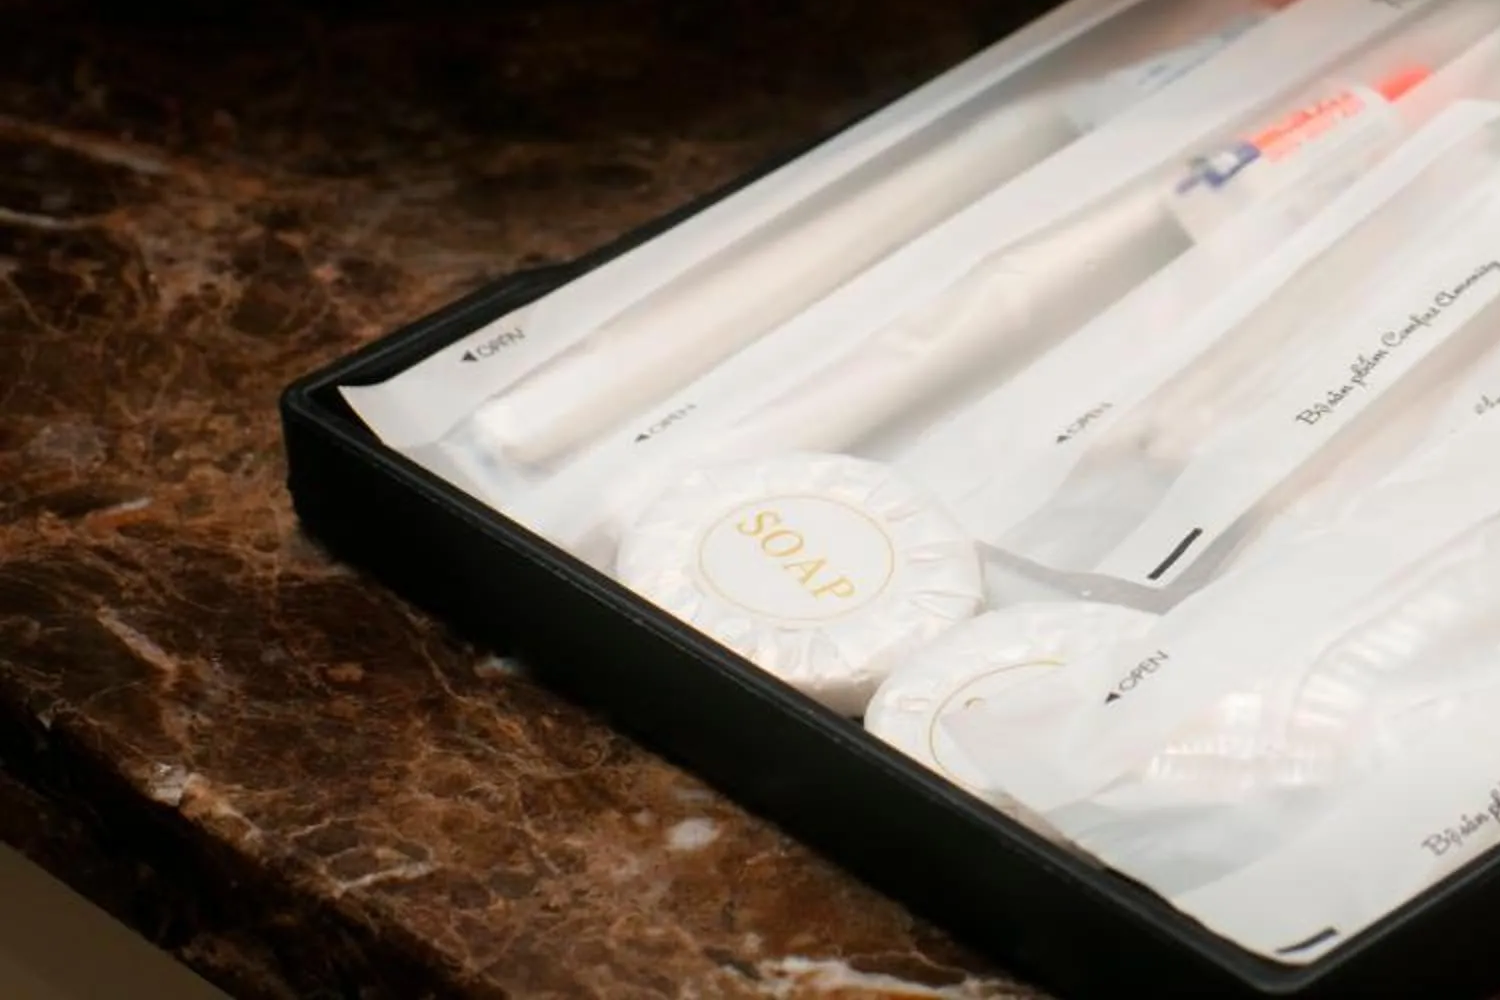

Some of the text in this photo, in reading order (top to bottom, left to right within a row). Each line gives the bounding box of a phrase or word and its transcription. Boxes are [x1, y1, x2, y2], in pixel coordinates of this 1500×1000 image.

[477, 327, 526, 359] OPEN
[736, 510, 855, 601] SOAP
[1118, 649, 1170, 692] OPEN
